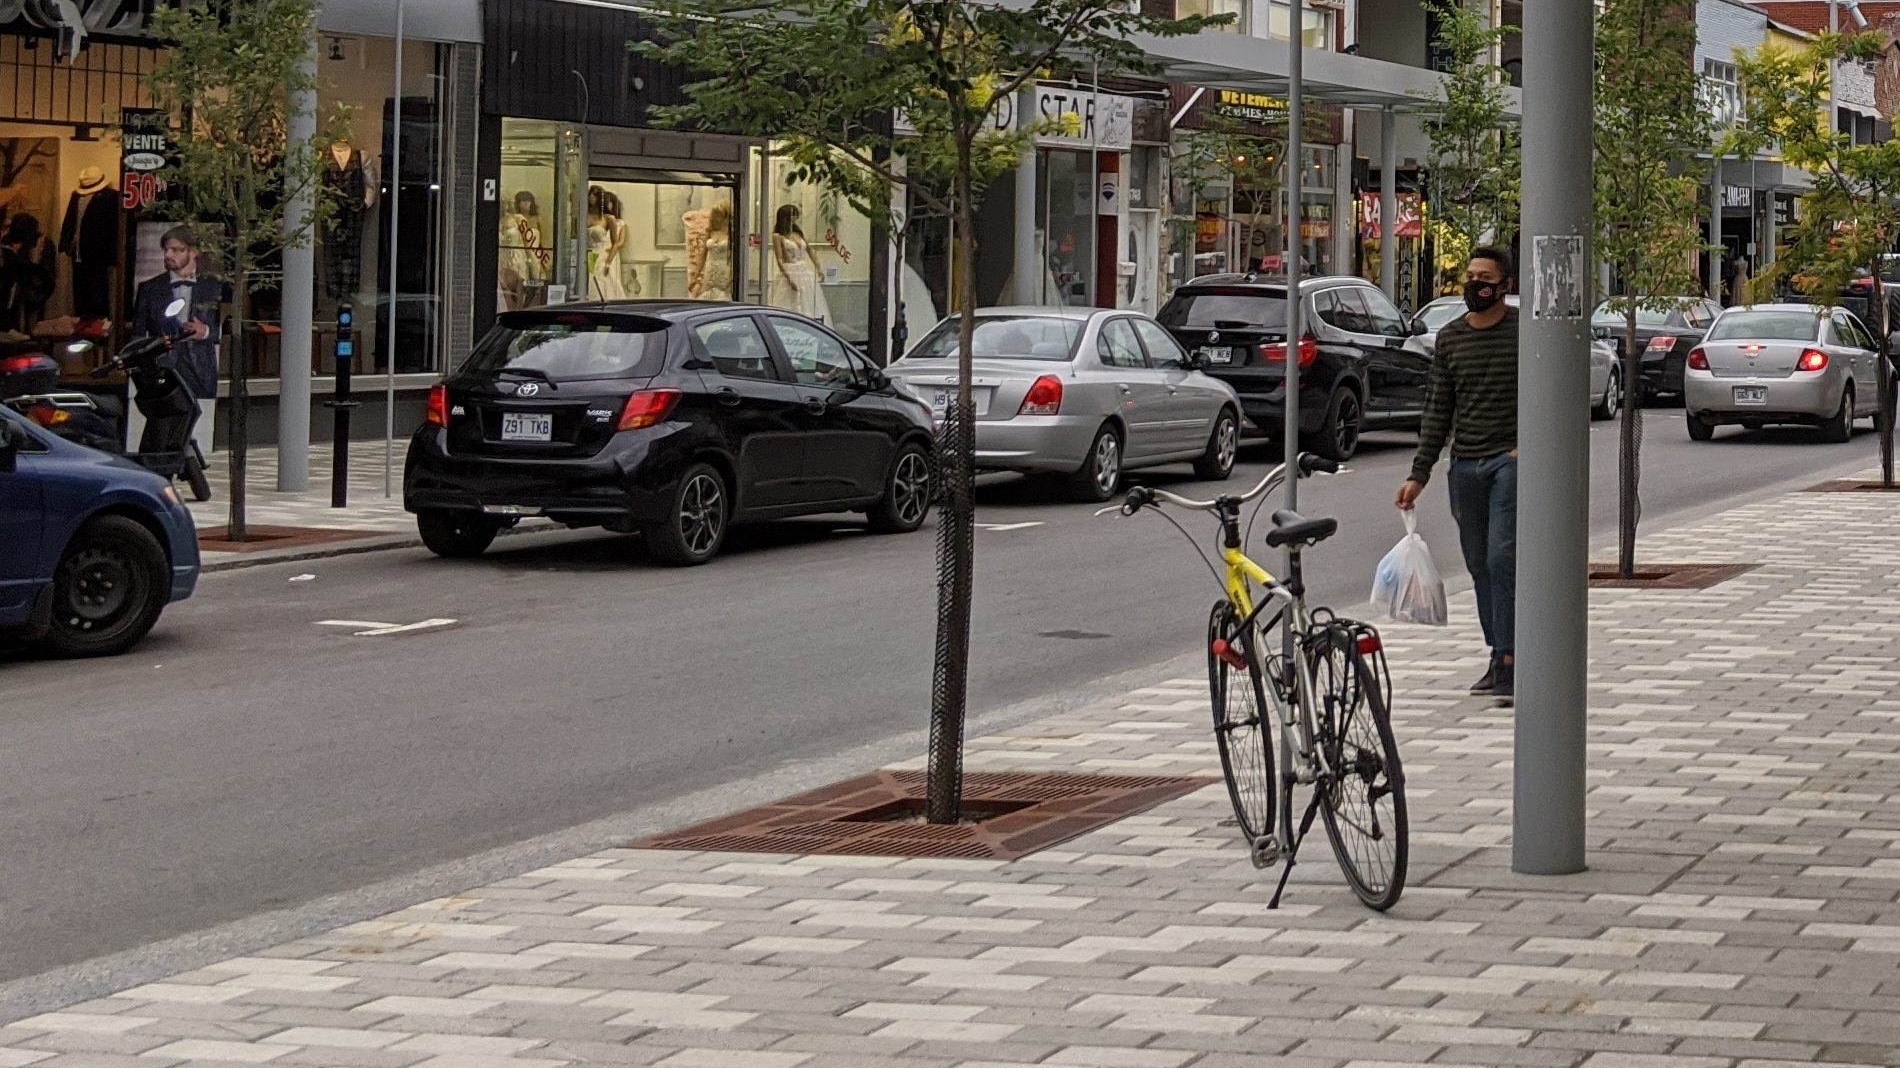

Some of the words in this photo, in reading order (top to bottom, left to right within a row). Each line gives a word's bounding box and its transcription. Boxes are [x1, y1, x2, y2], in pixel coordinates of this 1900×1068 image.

[1040, 93, 1095, 141] STAR
[124, 134, 165, 150] VENTE
[518, 219, 550, 270] SOLDE
[825, 228, 852, 264] SOLDE
[504, 419, 524, 434] Z91
[531, 419, 549, 434] TKB
